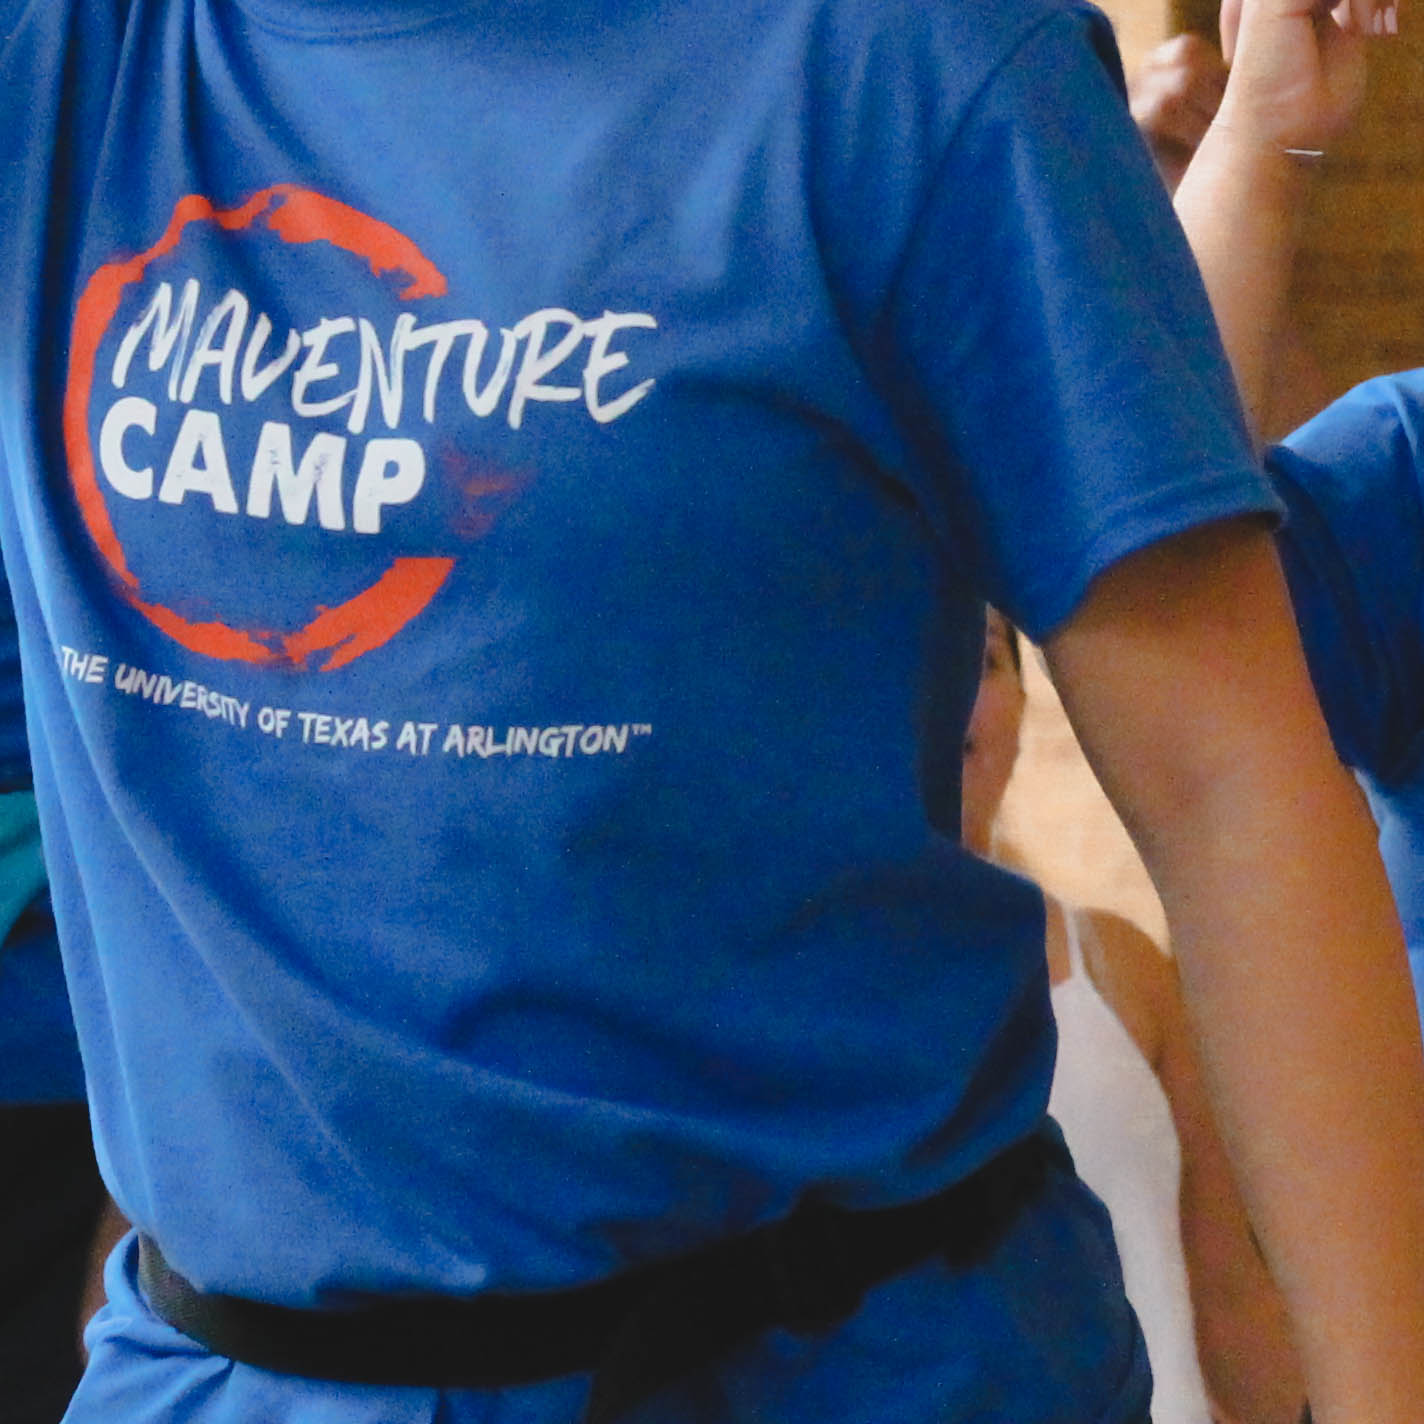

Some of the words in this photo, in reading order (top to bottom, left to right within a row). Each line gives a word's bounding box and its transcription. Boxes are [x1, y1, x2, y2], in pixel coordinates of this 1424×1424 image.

[111, 278, 657, 434] MAVENTURE
[99, 396, 425, 534] CAMP
[61, 645, 109, 684] THE
[114, 663, 250, 728] UNIVERSITY
[257, 706, 291, 738] OF
[297, 712, 389, 752] TEXAS
[396, 721, 438, 756] AT
